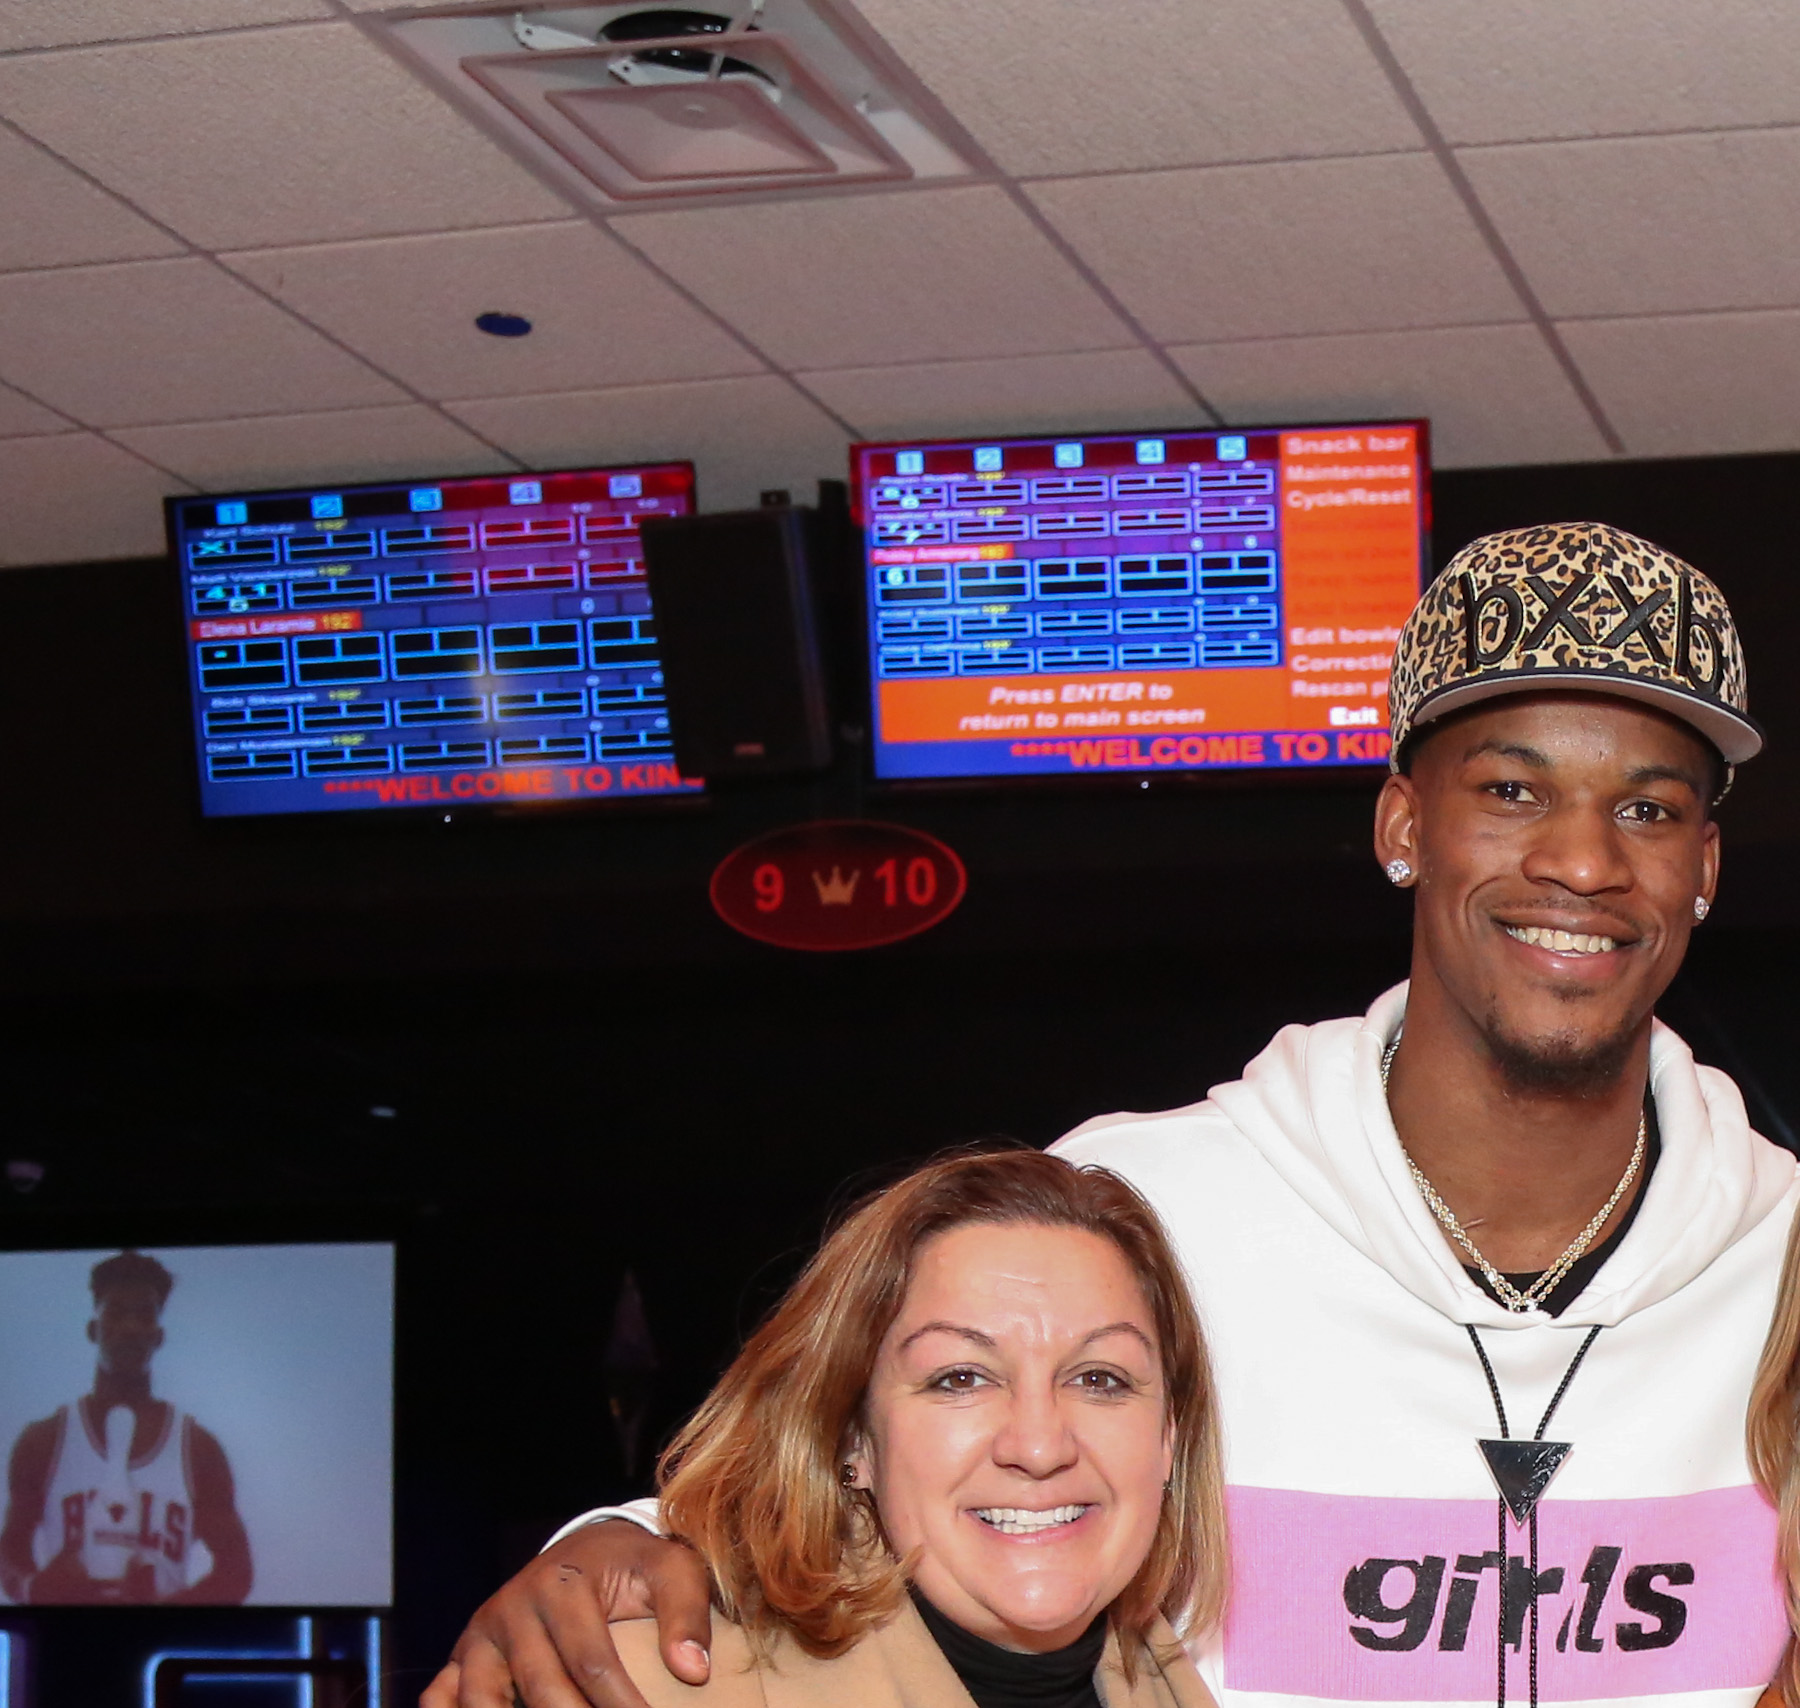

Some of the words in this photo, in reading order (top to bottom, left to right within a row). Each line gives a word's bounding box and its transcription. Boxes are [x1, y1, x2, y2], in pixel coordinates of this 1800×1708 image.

[1286, 436, 1362, 455] Snack
[1367, 435, 1409, 452] bar
[1286, 464, 1411, 481] Maintenance
[1286, 488, 1411, 511] Cycle/Reset
[1290, 627, 1334, 645] Edit
[989, 686, 1055, 705] Press
[1060, 682, 1145, 703] ENTER
[1148, 682, 1174, 701] to
[1292, 680, 1367, 698] Rescan
[959, 712, 1029, 731] return
[1035, 711, 1059, 729] to
[1063, 708, 1121, 727] main
[1126, 708, 1206, 726] screen
[1329, 706, 1379, 726] Exit
[1272, 732, 1329, 761] TO
[564, 766, 612, 792] TO
[753, 863, 784, 912] 9
[874, 857, 937, 906] 10
[1343, 1544, 1696, 1653] girls
